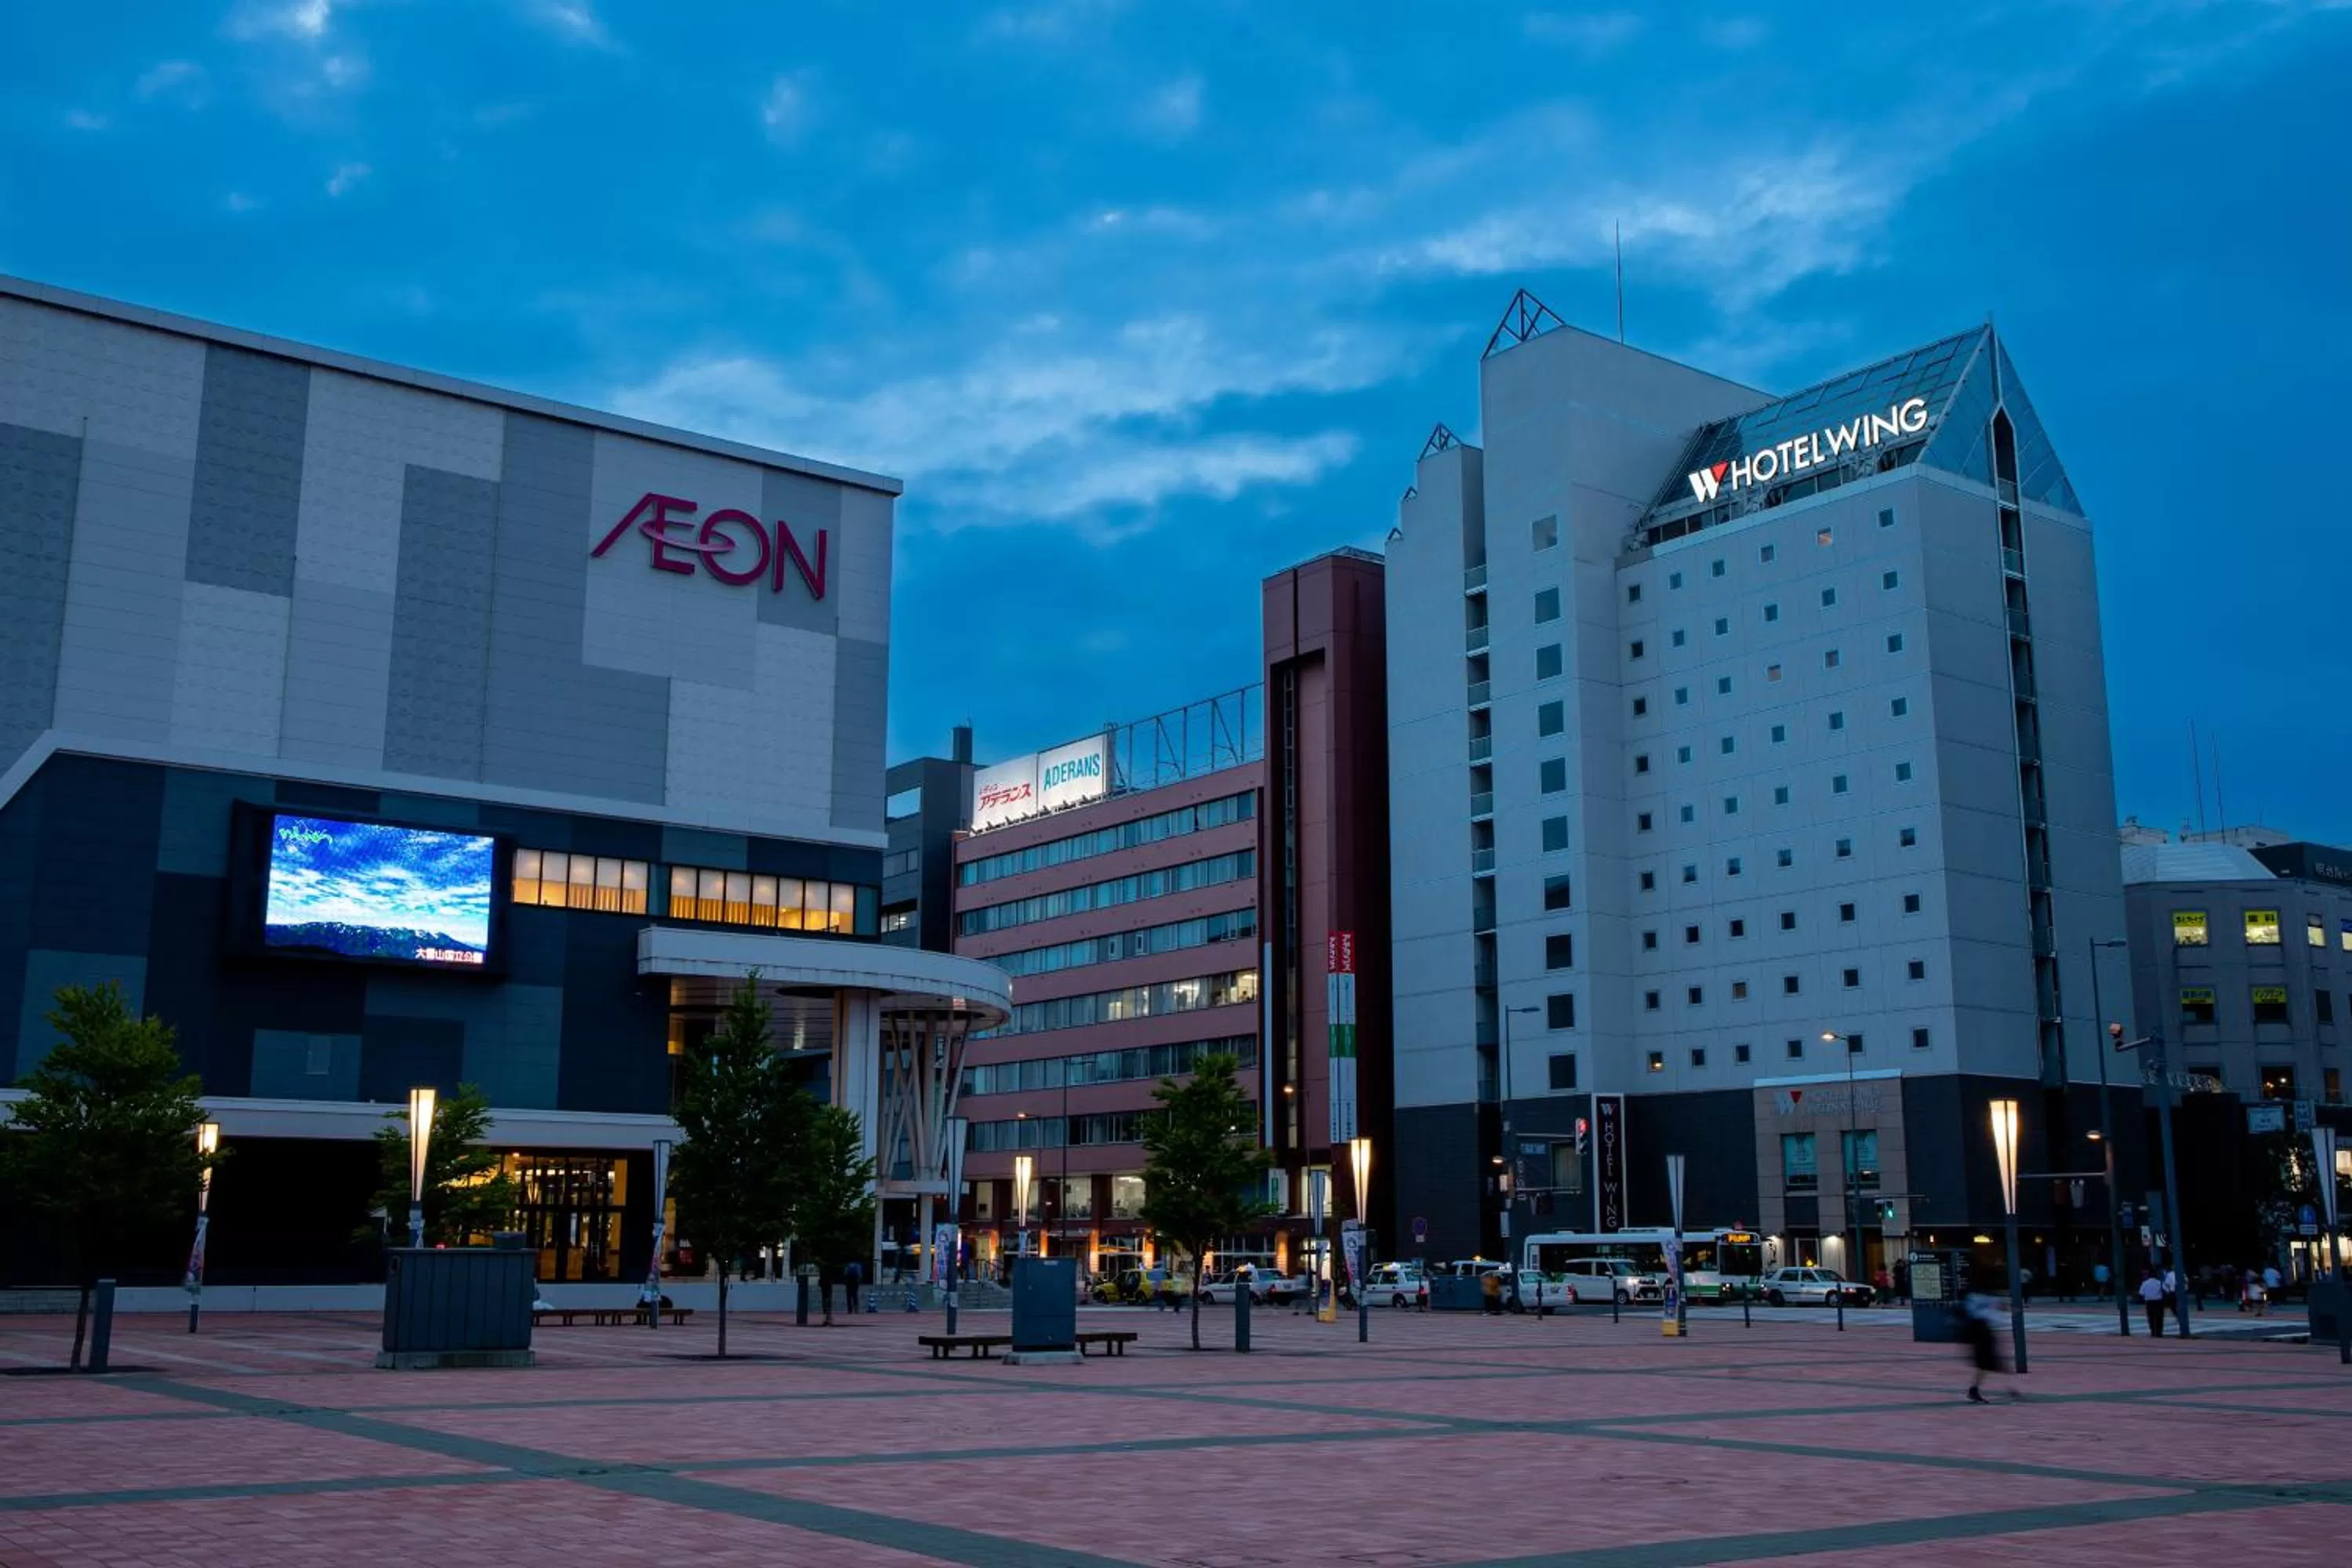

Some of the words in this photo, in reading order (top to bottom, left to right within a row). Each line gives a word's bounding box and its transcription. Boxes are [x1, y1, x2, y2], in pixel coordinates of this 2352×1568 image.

[1731, 432, 1824, 491] HOTEL
[1825, 397, 1929, 456] WING
[1044, 753, 1100, 791] ADERANS
[978, 783, 1032, 811] アデランス
[1599, 1103, 1617, 1116] W
[1603, 1122, 1616, 1177] HOTEL
[1603, 1181, 1619, 1229] WING
